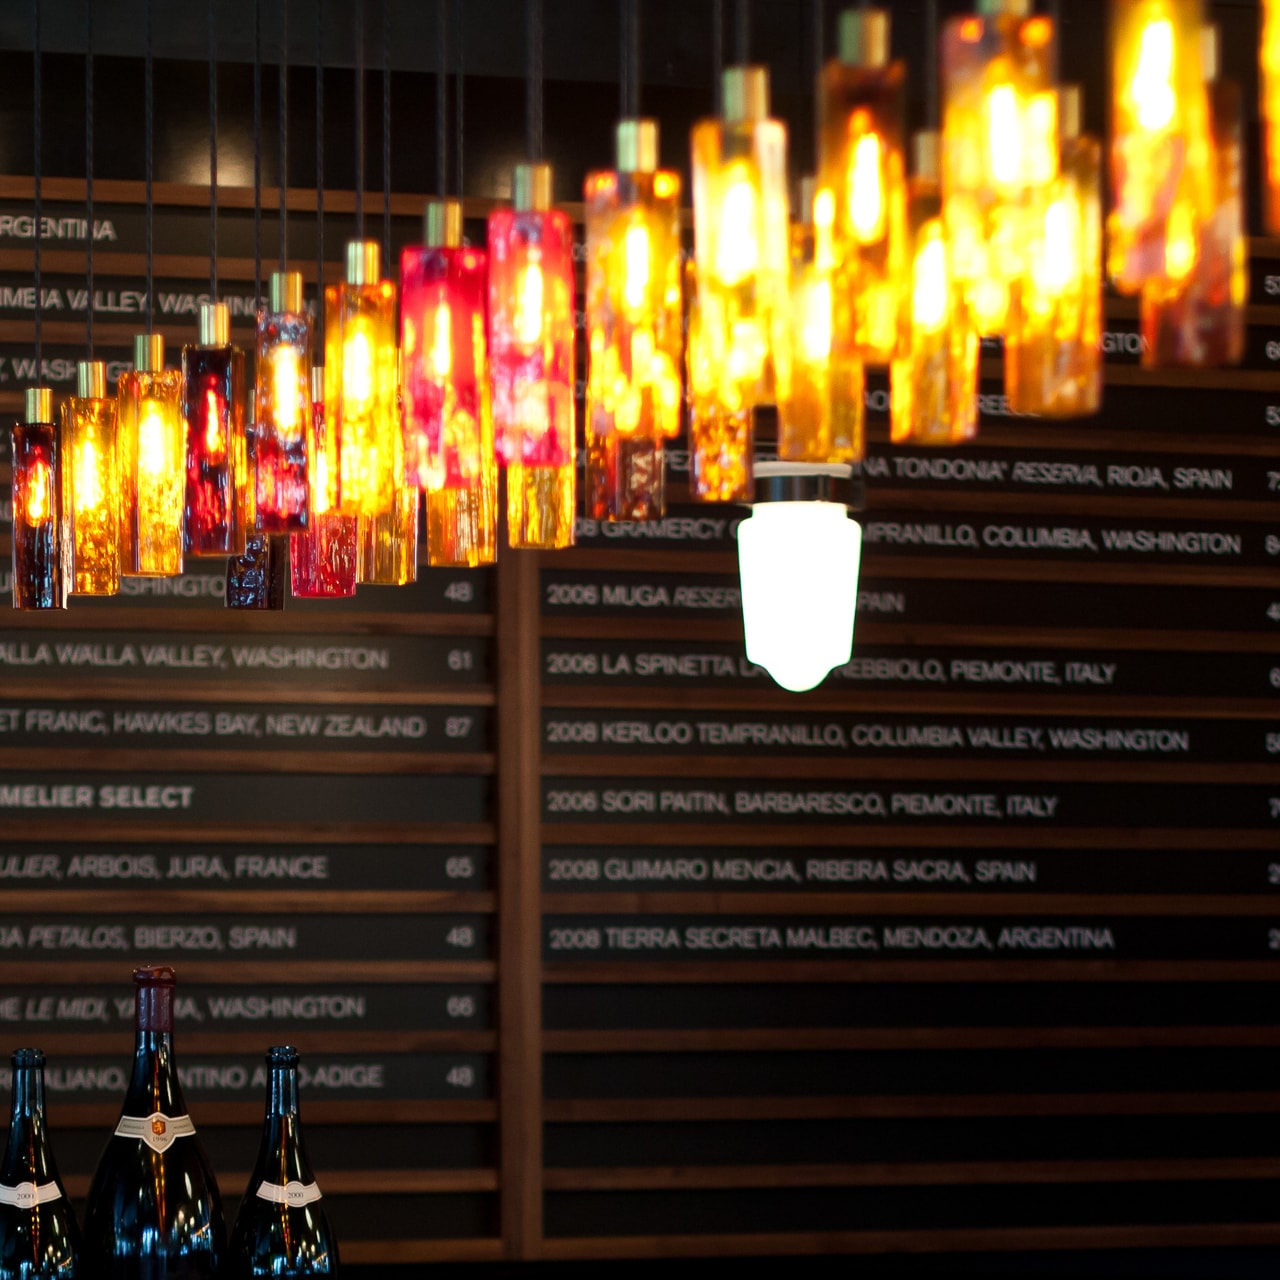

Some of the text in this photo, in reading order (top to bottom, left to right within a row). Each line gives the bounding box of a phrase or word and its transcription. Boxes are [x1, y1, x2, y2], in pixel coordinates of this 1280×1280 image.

[1011, 461, 1104, 488] RESERVA,
[1172, 467, 1233, 488] SPAIN
[443, 582, 474, 602] 48
[55, 644, 139, 665] WALLA
[140, 645, 230, 671] VALLEY,
[230, 646, 390, 669] WASHINGTON
[447, 650, 473, 670] 61
[25, 709, 108, 736] FRANC,
[113, 711, 213, 734] HAWKES
[214, 713, 262, 739] BAY,
[265, 714, 323, 735] NEW
[322, 714, 427, 737] ZEALAND
[444, 716, 473, 736] 87
[546, 721, 1189, 752] 2008 KERLOO TEMPRANILLO, COLUMBIA VALLEY, WASHINGTON
[98, 786, 194, 808] SELECT
[66, 855, 162, 882] ARBOIS,
[165, 856, 231, 882] JURA,
[234, 856, 329, 877] FRANCE
[547, 859, 603, 880] 2008
[805, 860, 889, 880] RIBEIRA
[892, 860, 971, 885] SACRA,
[975, 861, 1036, 880] SPAIN
[548, 928, 603, 948] 2008
[603, 928, 682, 948] TIERRA
[684, 928, 783, 948] SECRETA
[785, 928, 879, 952] MALBEC,
[883, 928, 993, 952] MENDOZA,
[997, 928, 1114, 948] ARGENTINA
[24, 998, 55, 1020] LE
[207, 996, 366, 1018] WASHINGTON
